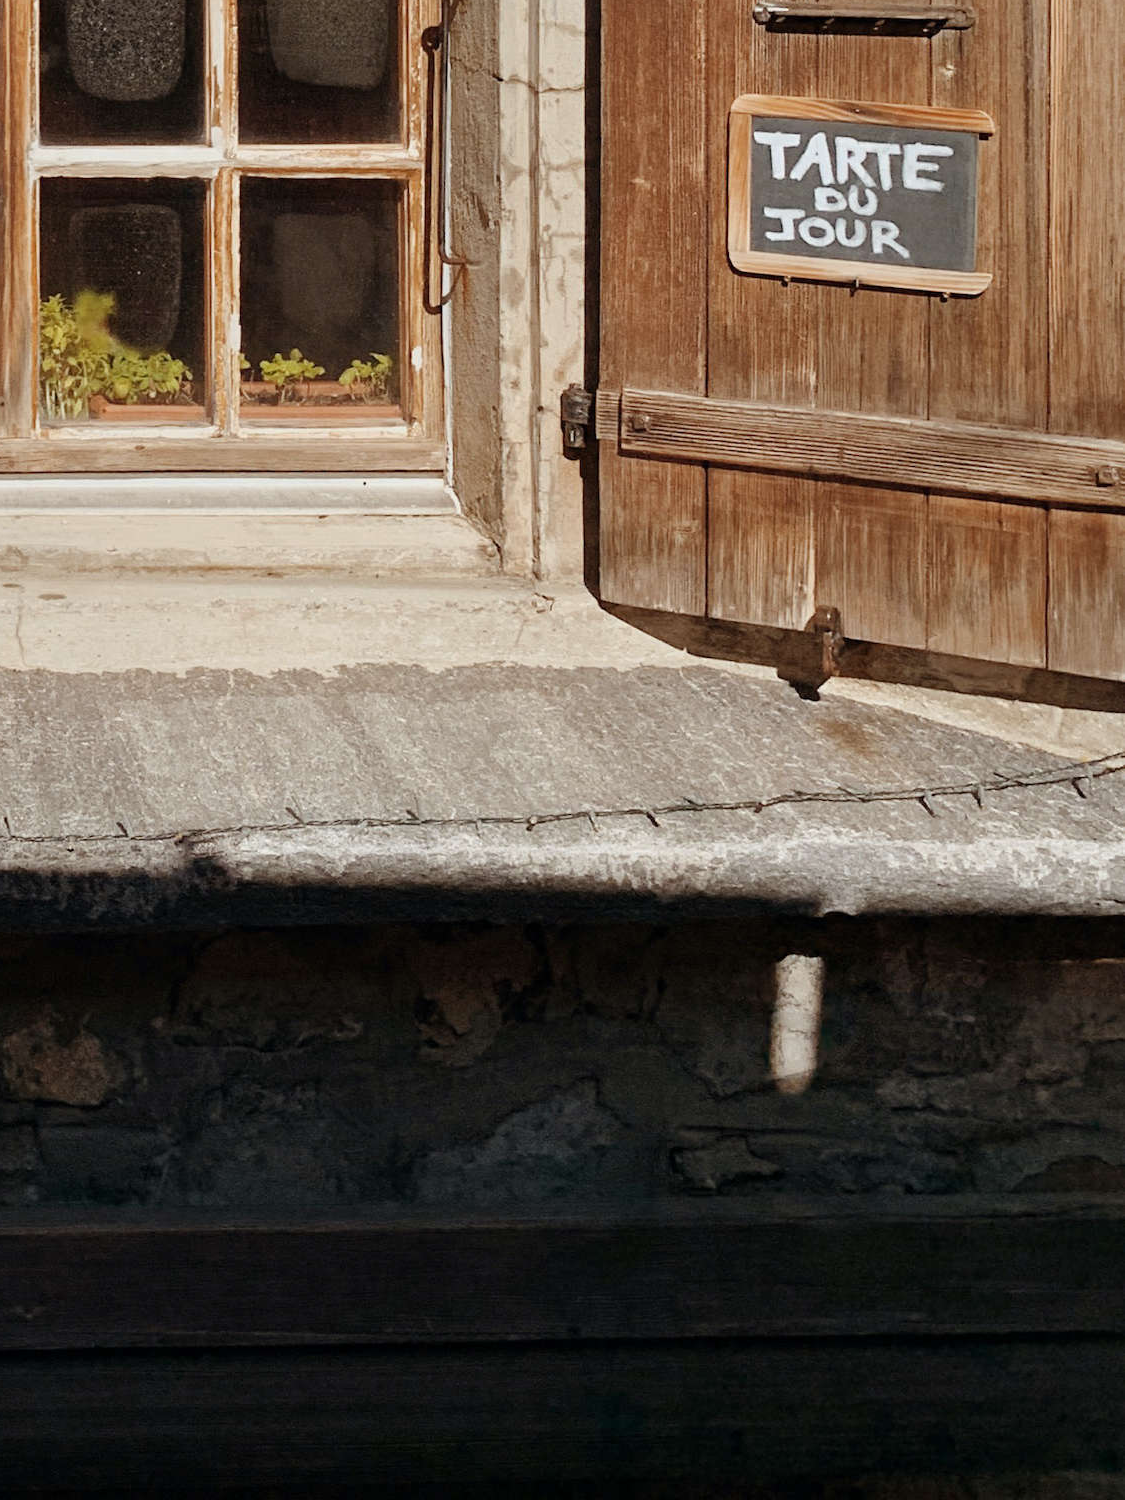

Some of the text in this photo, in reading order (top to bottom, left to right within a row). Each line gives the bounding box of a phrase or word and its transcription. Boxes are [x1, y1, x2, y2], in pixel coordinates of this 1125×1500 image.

[753, 131, 954, 193] TARTE
[814, 185, 878, 216] DU
[763, 206, 911, 259] JOUR
